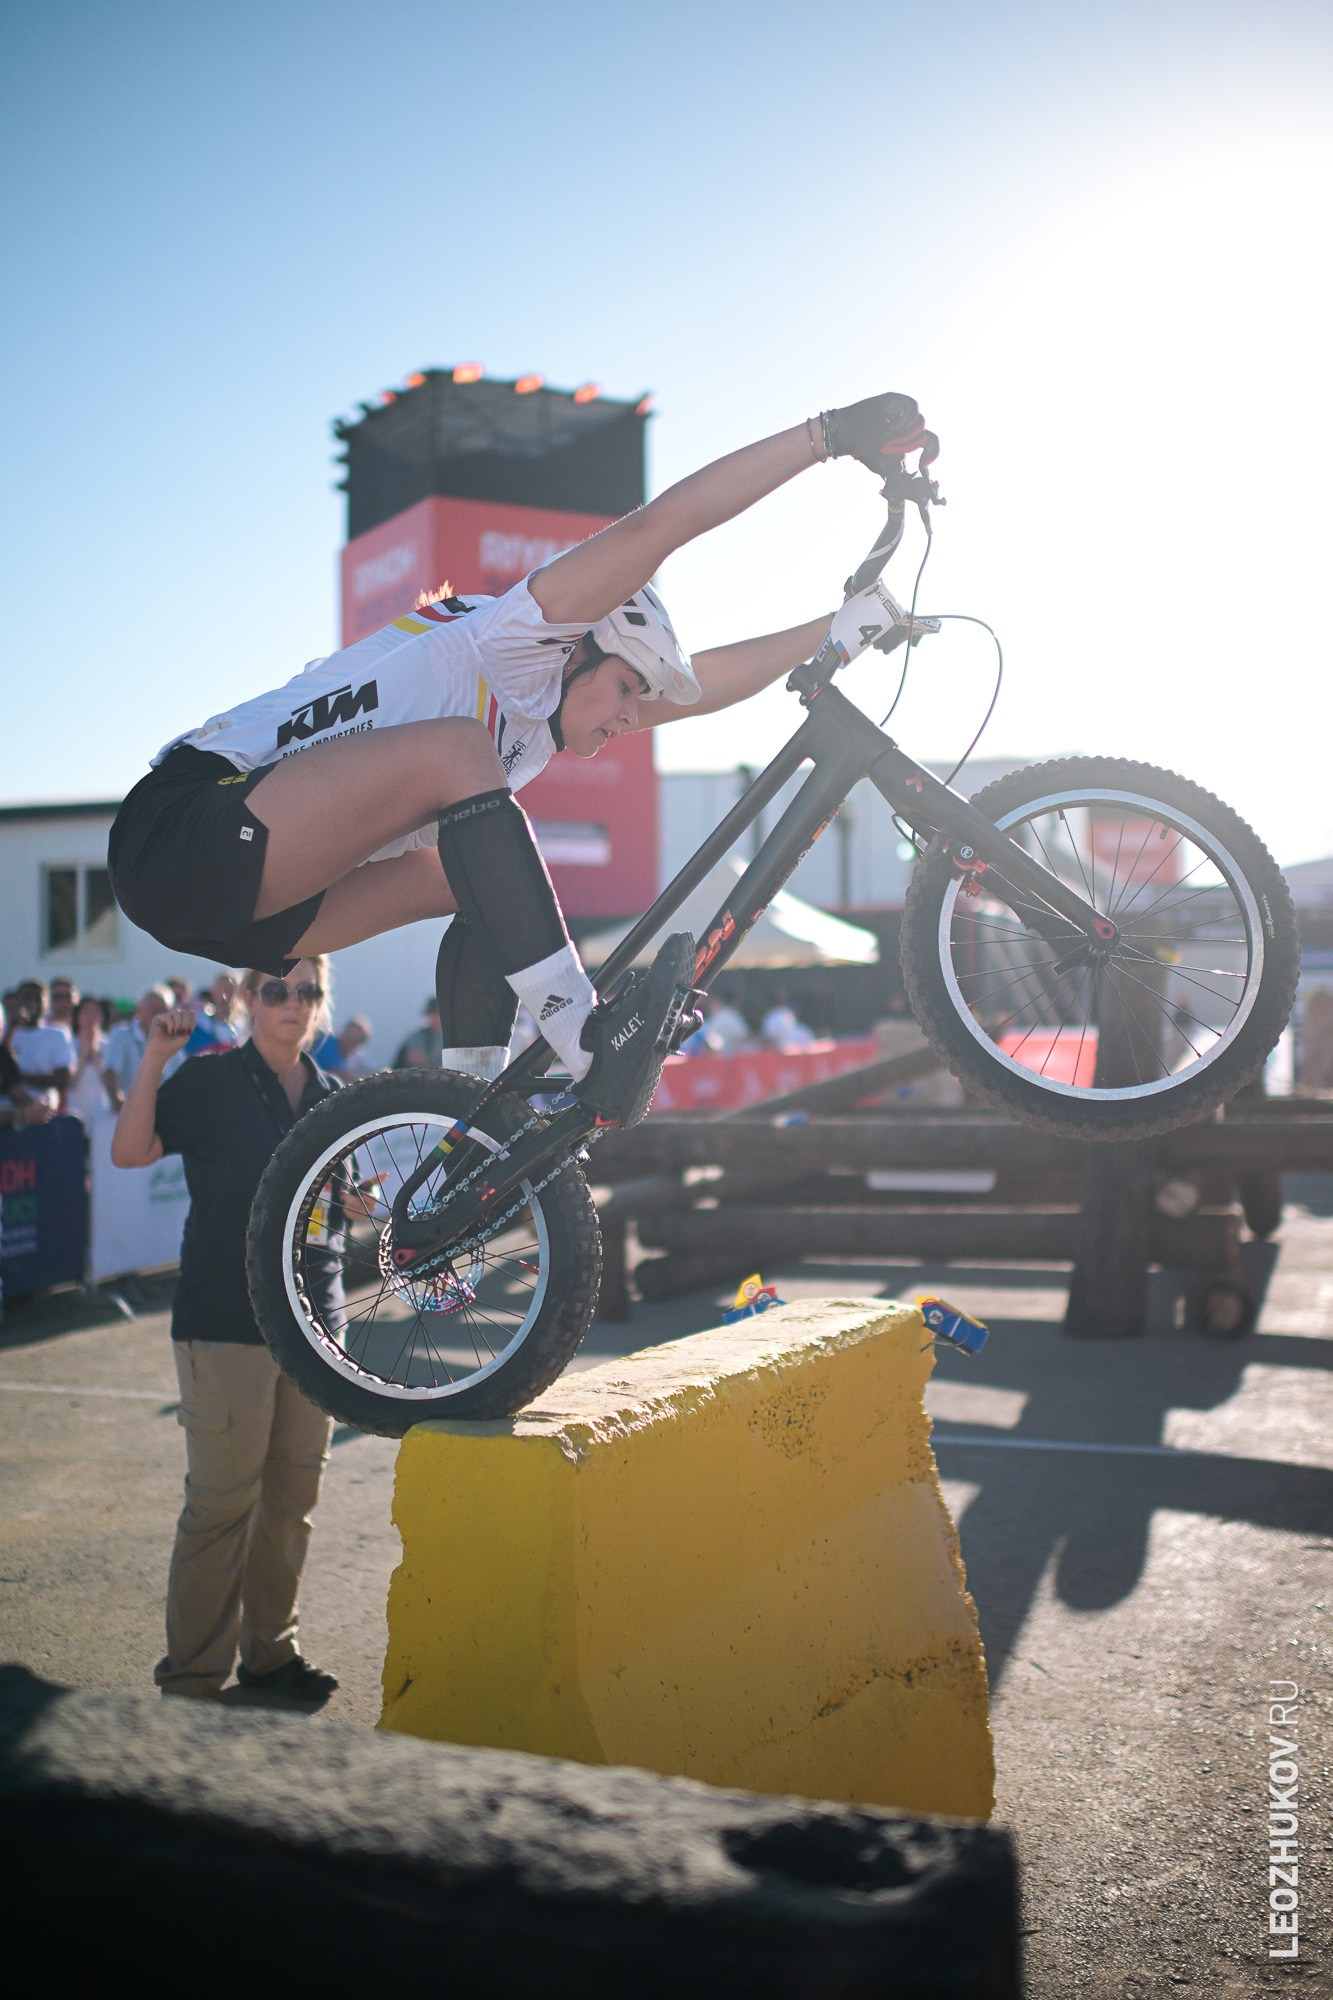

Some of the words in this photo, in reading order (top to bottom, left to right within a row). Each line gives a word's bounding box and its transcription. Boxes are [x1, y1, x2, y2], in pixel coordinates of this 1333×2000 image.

[859, 624, 883, 648] 4
[276, 679, 379, 751] KTM
[540, 998, 574, 1021] adidas
